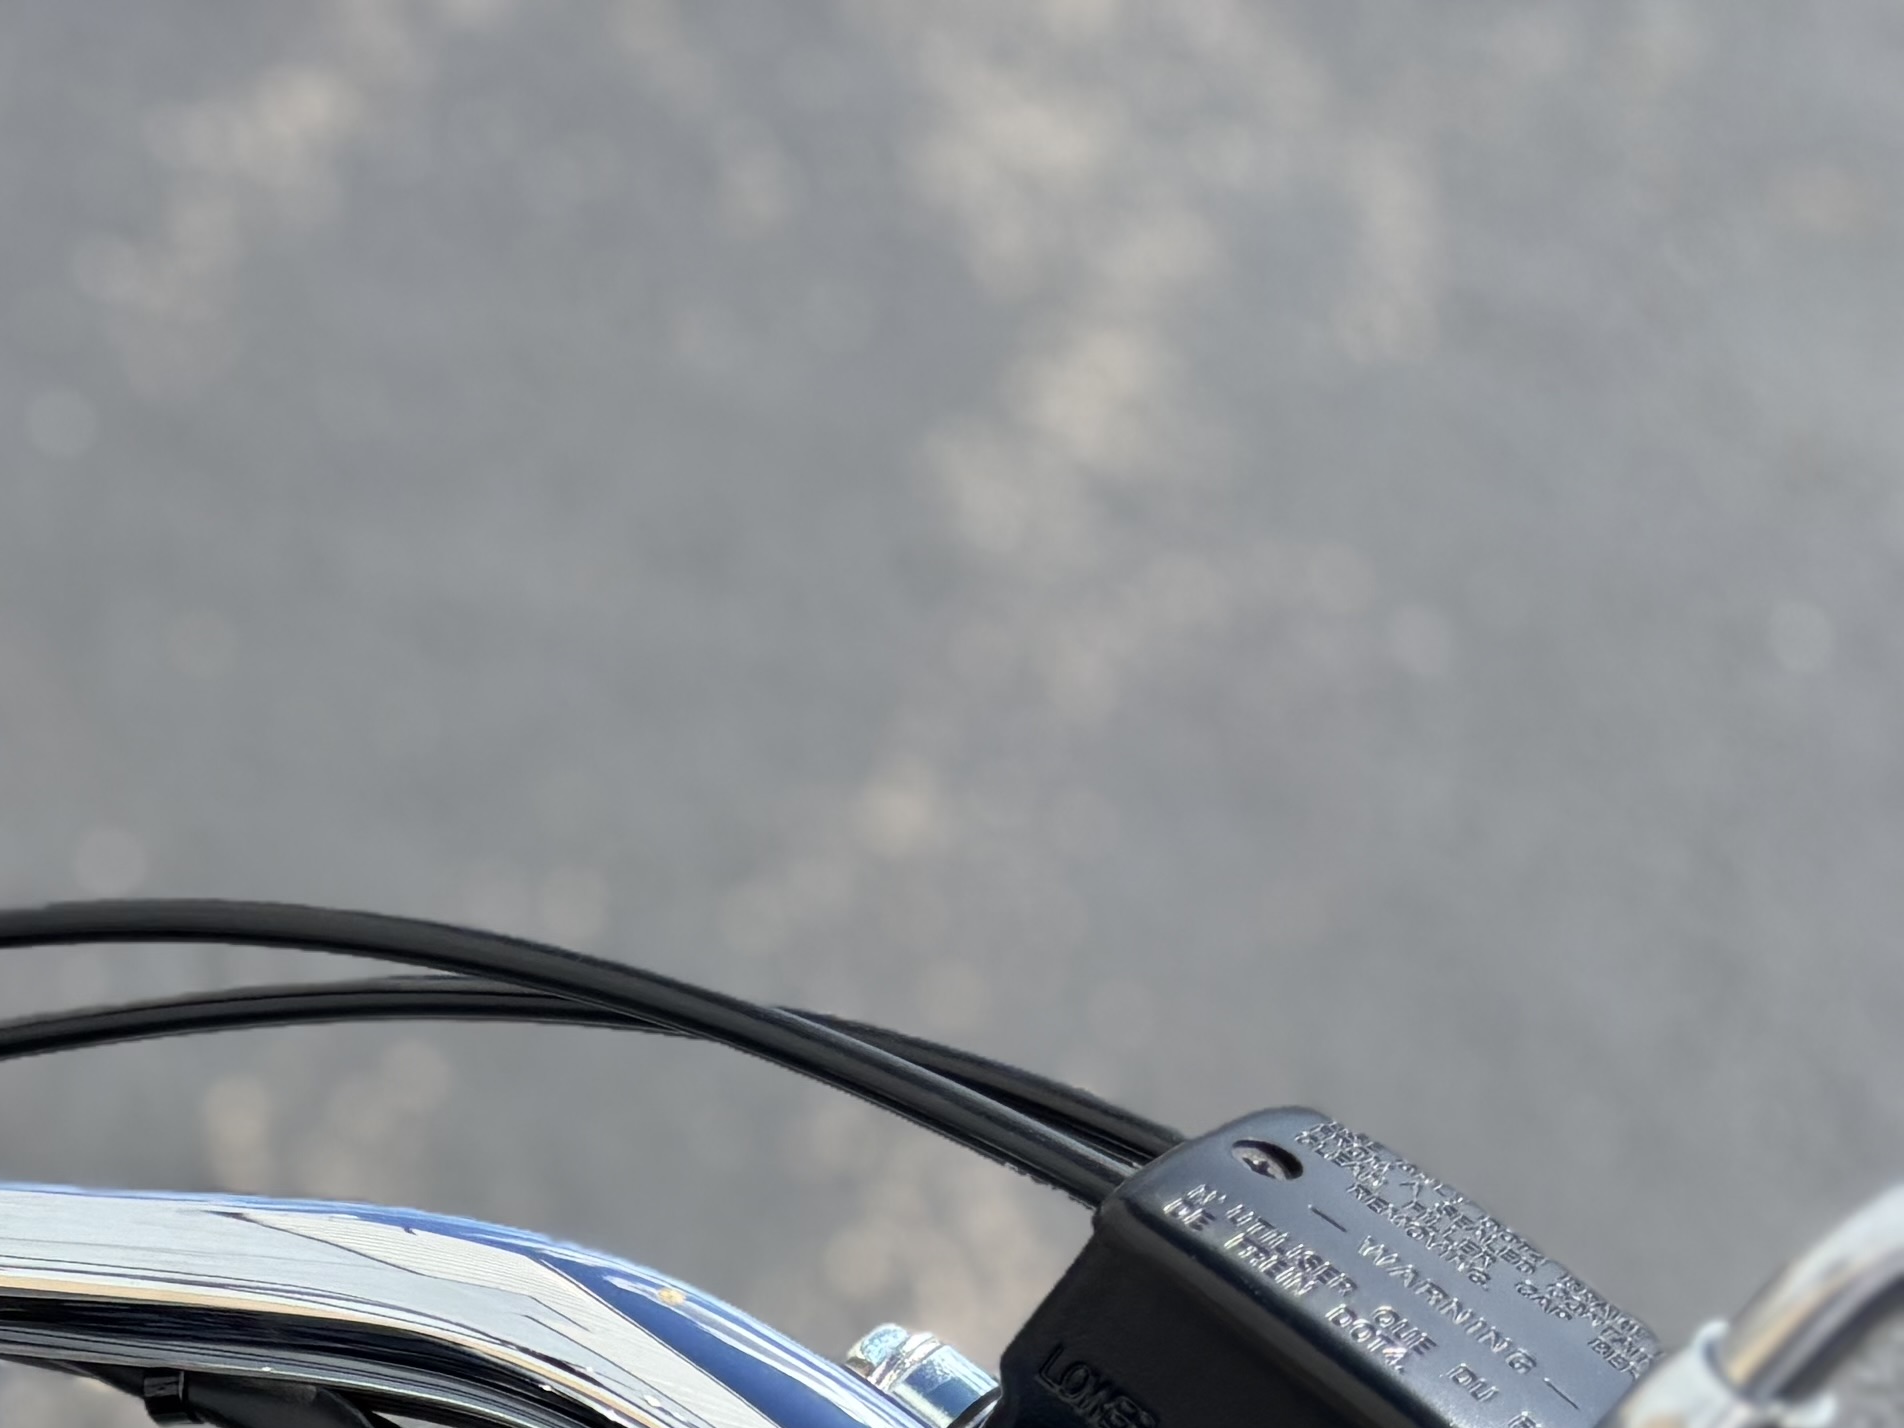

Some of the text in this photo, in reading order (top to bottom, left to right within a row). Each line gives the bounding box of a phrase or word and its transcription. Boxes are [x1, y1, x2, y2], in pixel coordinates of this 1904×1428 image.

[1399, 1180, 1417, 1199] A
[1163, 1197, 1216, 1231] DE
[1224, 1232, 1316, 1296] FREIN
[1358, 1235, 1537, 1375] WARNING
[1513, 1280, 1572, 1318] CAP
[1371, 1306, 1438, 1356] QUE
[1446, 1362, 1499, 1402] DU
